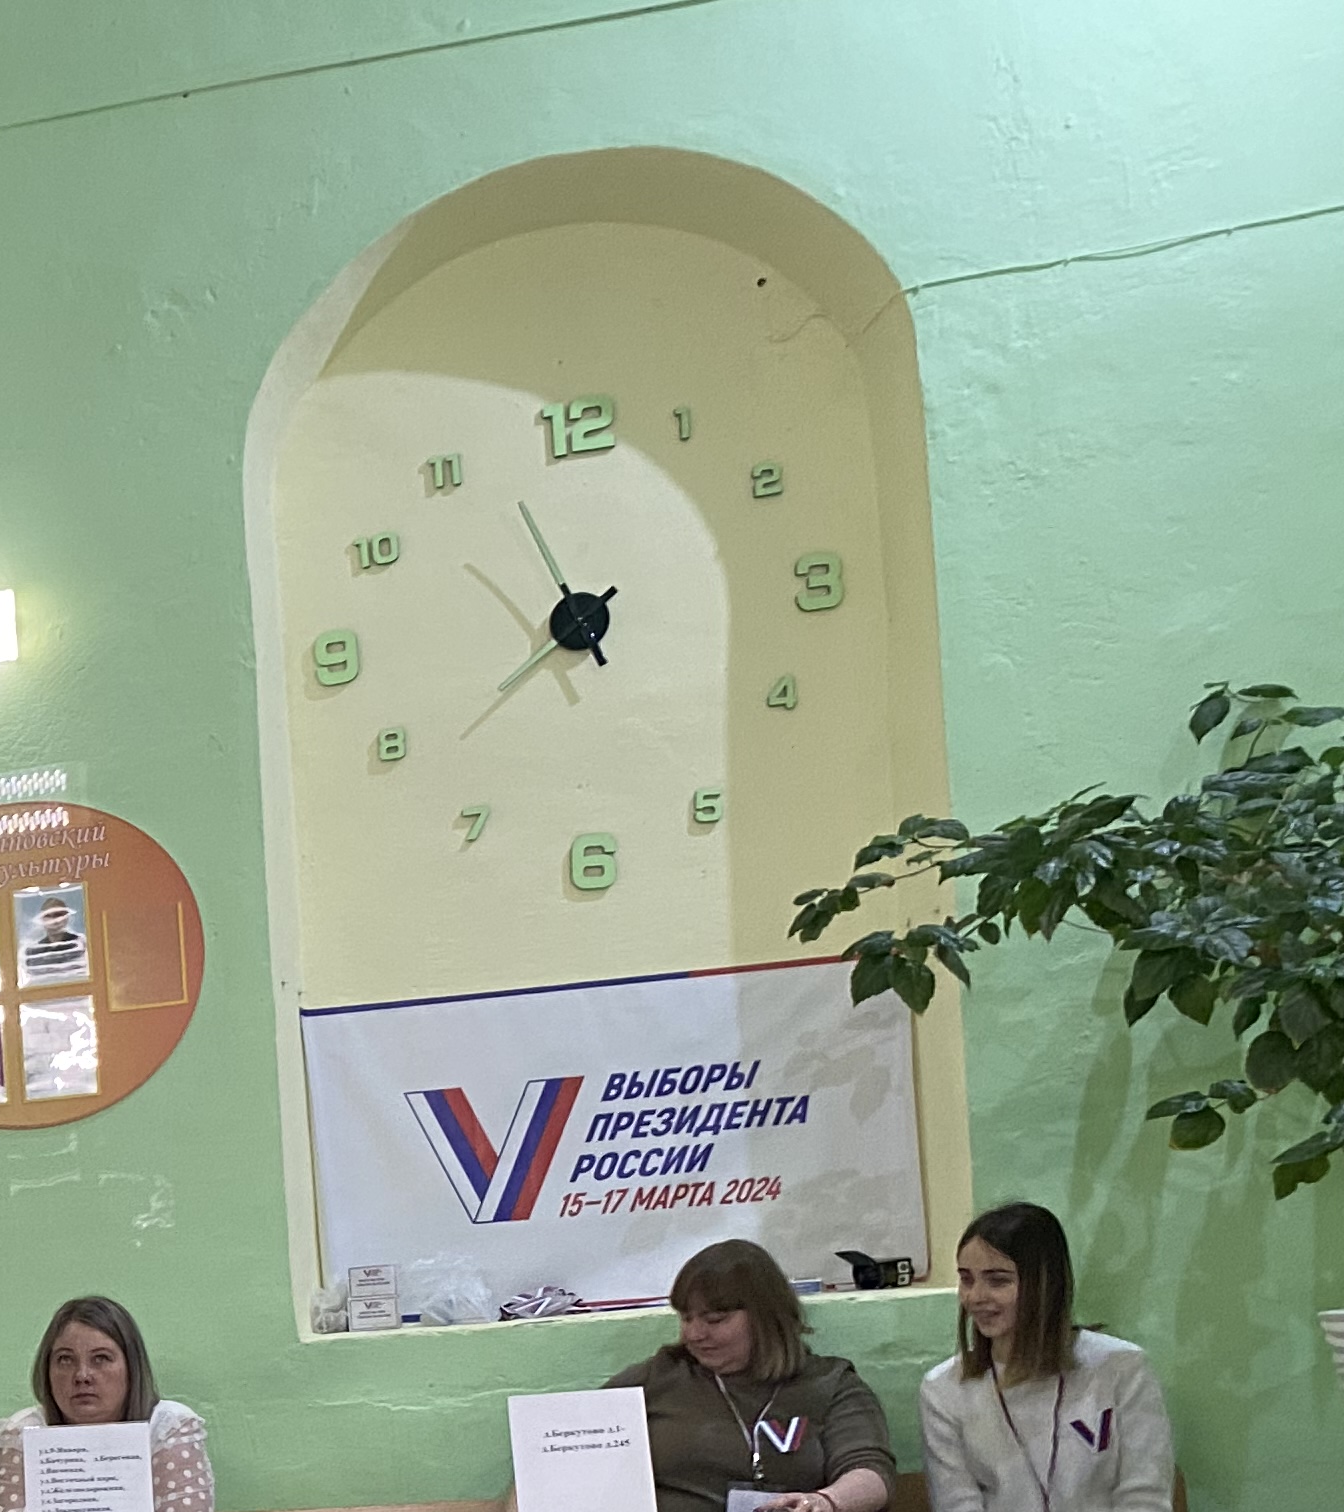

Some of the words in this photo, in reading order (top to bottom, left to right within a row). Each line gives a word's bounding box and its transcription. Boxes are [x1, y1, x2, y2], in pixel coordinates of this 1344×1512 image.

[540, 396, 616, 458] 12
[673, 406, 692, 440] 1
[427, 453, 464, 489] 11
[751, 460, 784, 498] 2
[354, 531, 400, 568] 10
[794, 551, 845, 612] 3
[314, 629, 360, 686] 9
[766, 674, 798, 710] 4
[377, 726, 407, 761] 8
[461, 804, 490, 842] 7
[694, 787, 723, 823] 5
[569, 832, 618, 890] 6
[600, 1059, 760, 1102] ВЫБОРЫ
[584, 1094, 811, 1143] ПРЕЗИДЕНТА
[569, 1142, 714, 1183] РОССИИ
[630, 1181, 713, 1212] МАРТА
[719, 1175, 782, 1205] 2024
